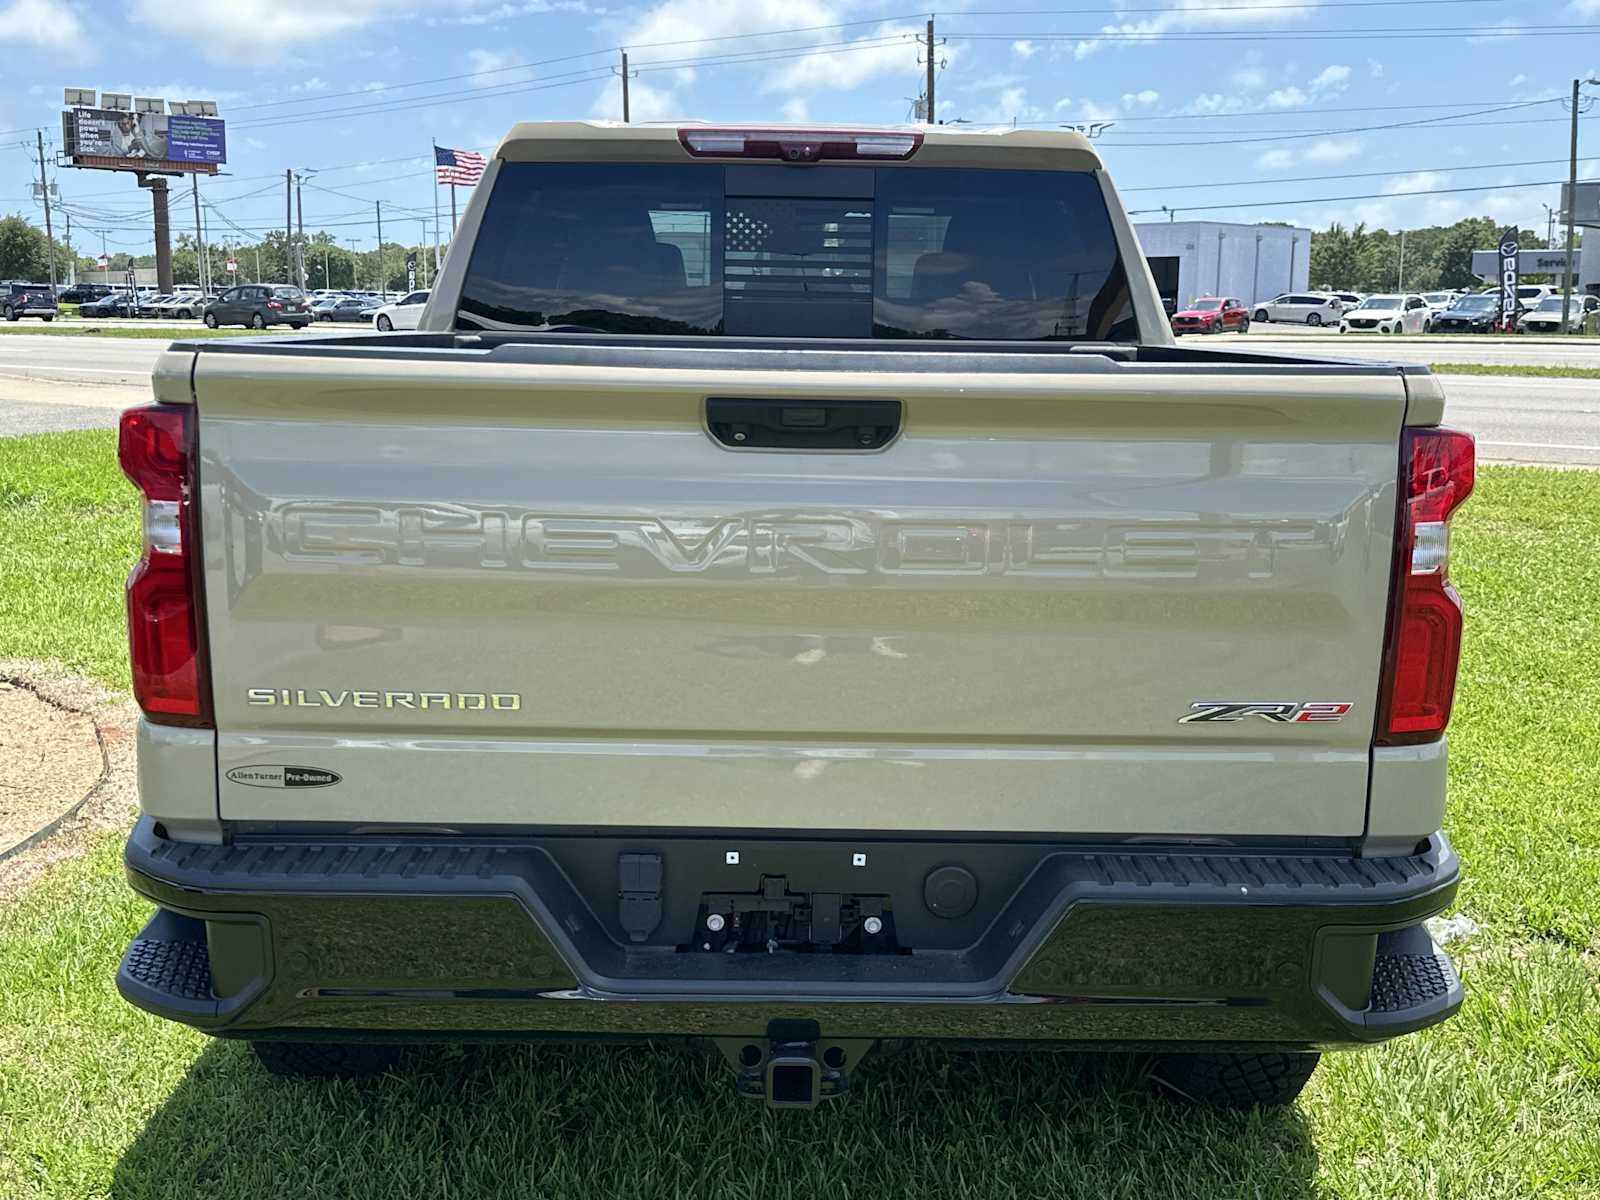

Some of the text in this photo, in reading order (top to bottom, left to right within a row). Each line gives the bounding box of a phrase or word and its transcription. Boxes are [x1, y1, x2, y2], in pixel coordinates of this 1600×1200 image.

[78, 110, 91, 118] Life
[1537, 258, 1576, 267] Servi
[278, 503, 1322, 578] CHEVROLET
[247, 688, 521, 711] SILVERADO
[1178, 702, 1355, 724] ZR2
[231, 771, 333, 783] Allen Turner Pre-Owned
